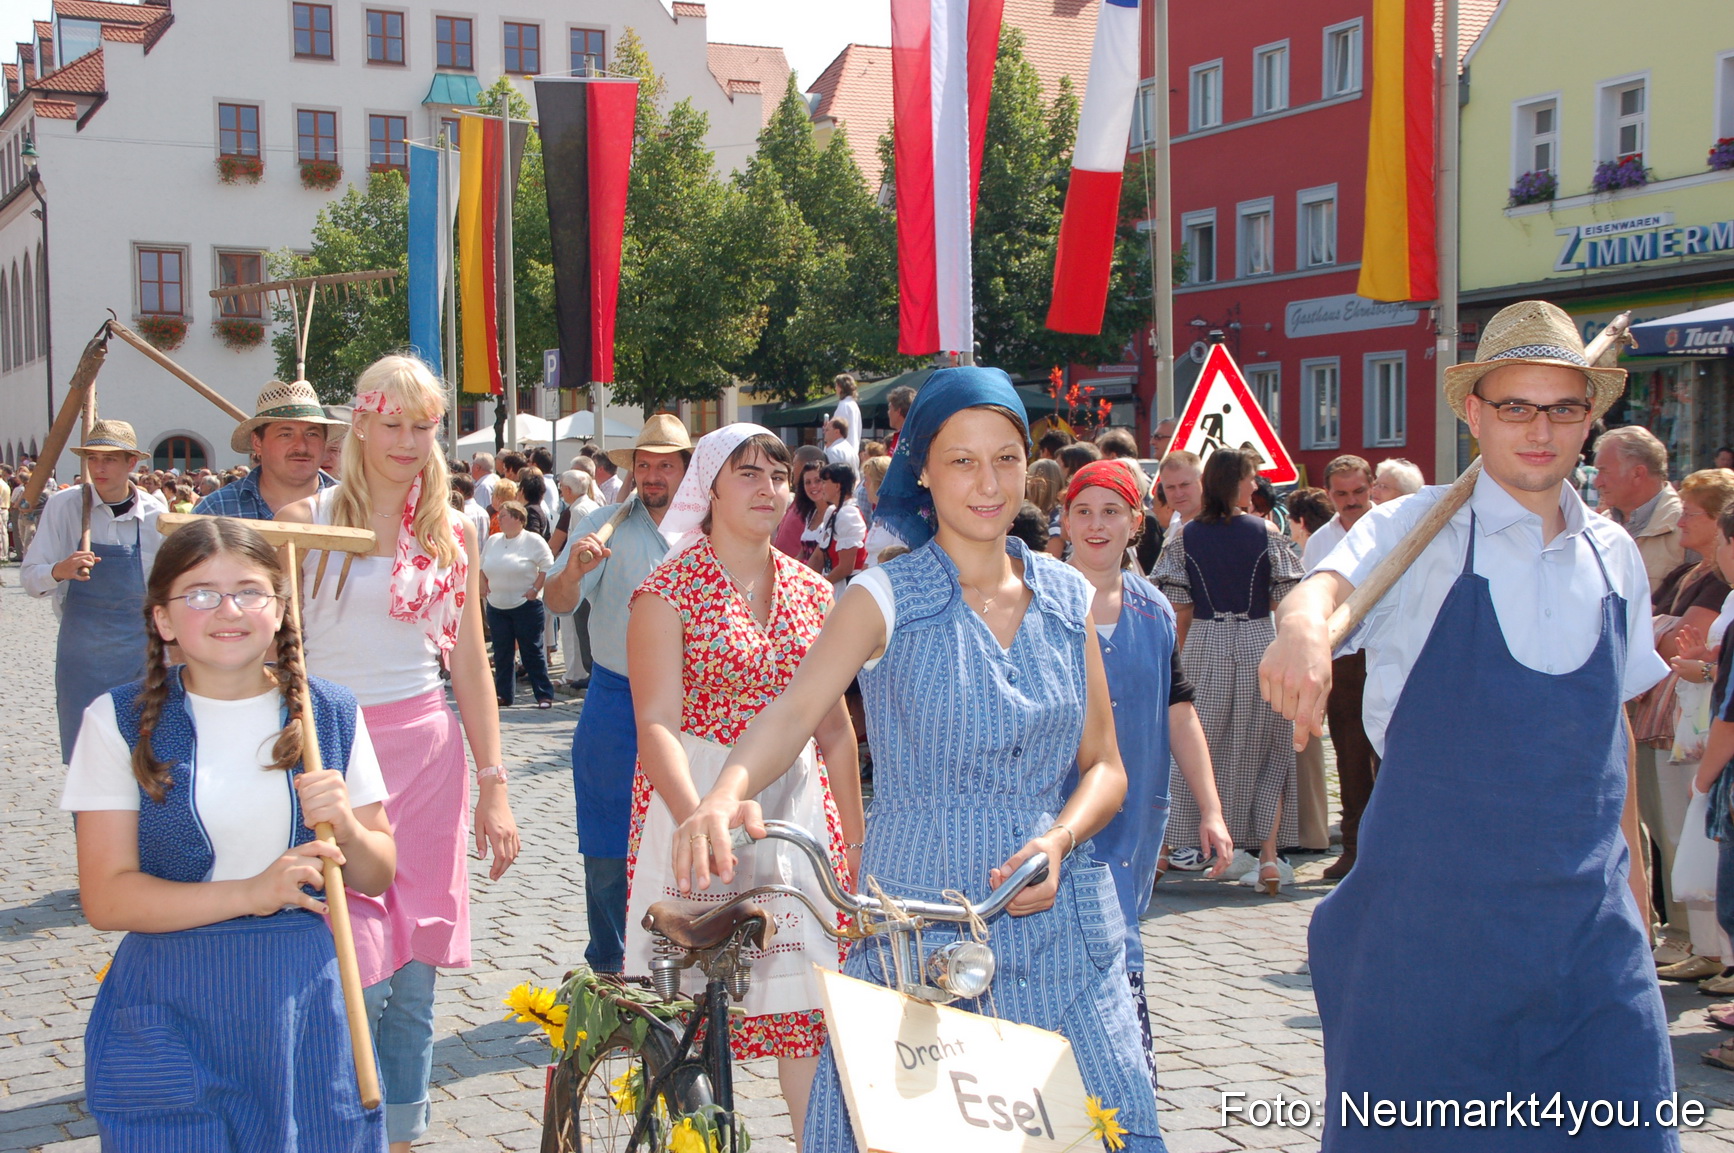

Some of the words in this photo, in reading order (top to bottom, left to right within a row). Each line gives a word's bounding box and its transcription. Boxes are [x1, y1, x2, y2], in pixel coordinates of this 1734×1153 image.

[1585, 216, 1661, 236] EISENWAREN
[1291, 305, 1341, 333] Gasthaus
[1684, 325, 1734, 348] Tuch
[547, 354, 557, 384] P
[894, 1036, 967, 1071] Draht
[949, 1069, 1055, 1140] Esel
